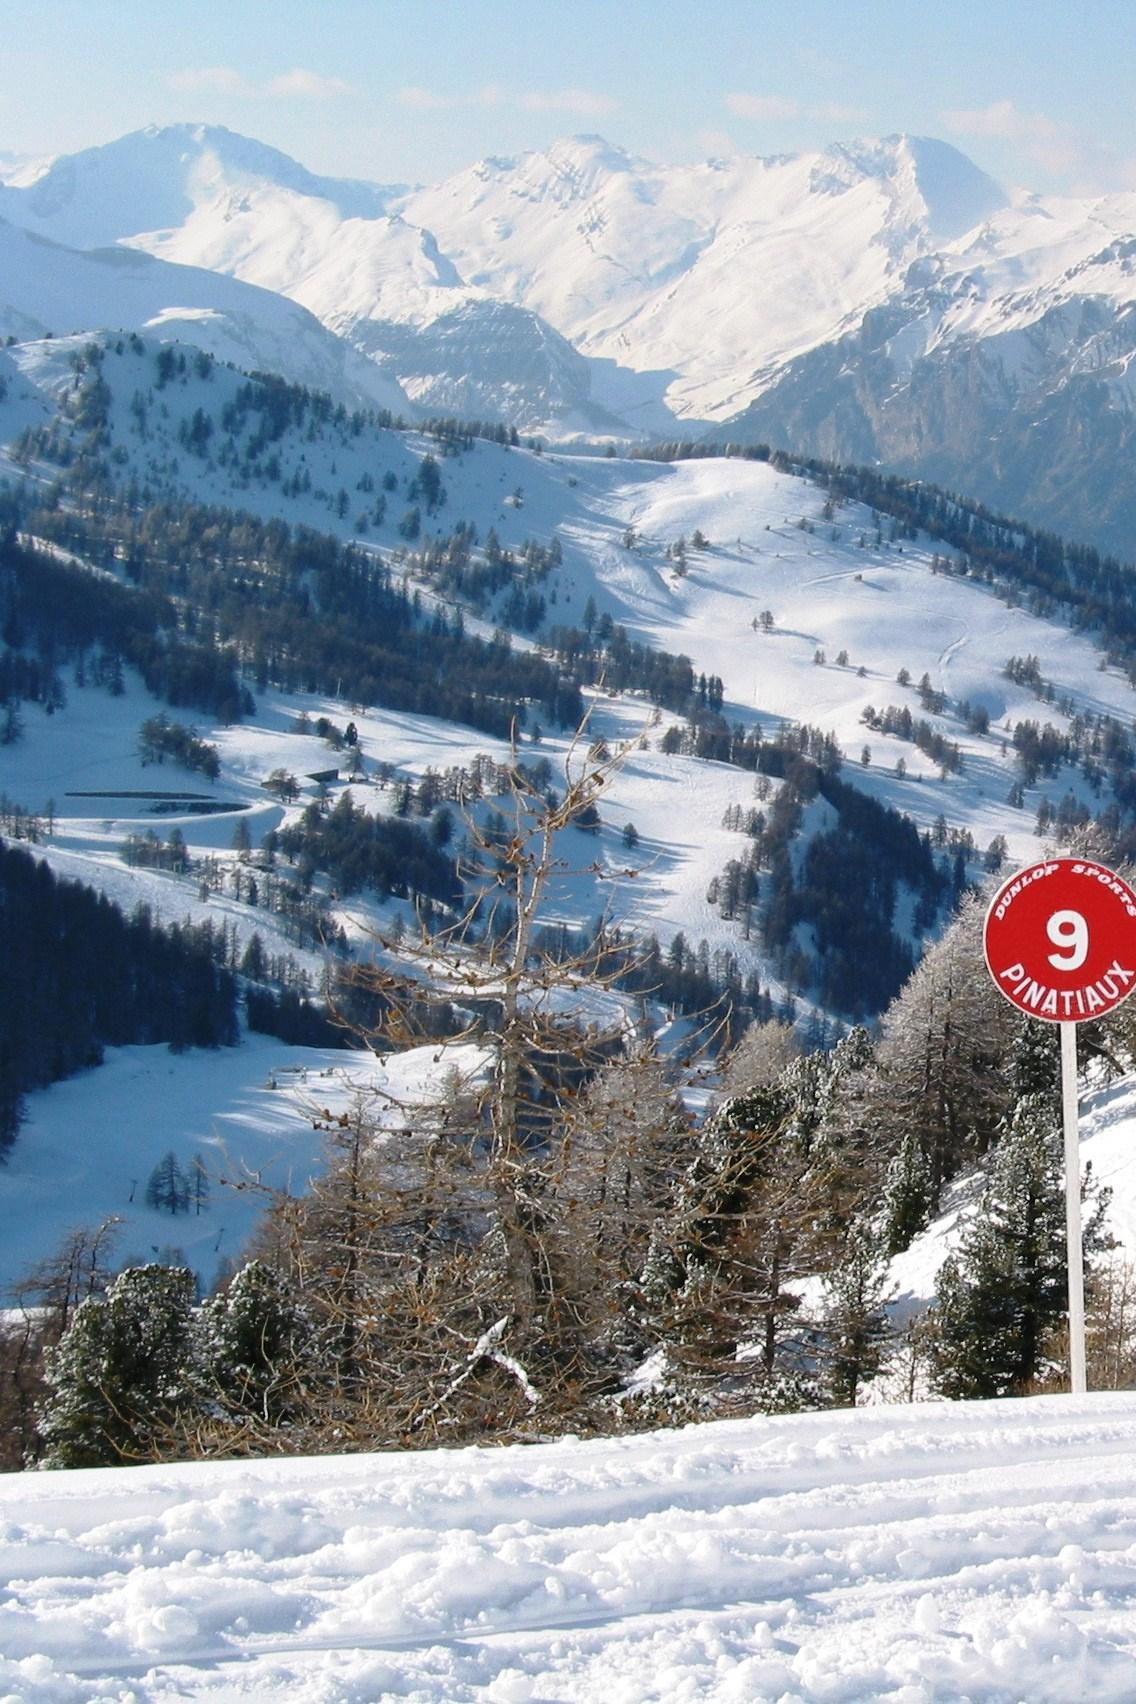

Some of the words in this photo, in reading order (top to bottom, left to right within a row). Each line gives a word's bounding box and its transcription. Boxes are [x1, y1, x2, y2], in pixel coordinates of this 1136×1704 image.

[995, 863, 1060, 921] DUNLOP
[1046, 909, 1090, 972] 9
[999, 959, 1136, 1016] PINATIAUX
